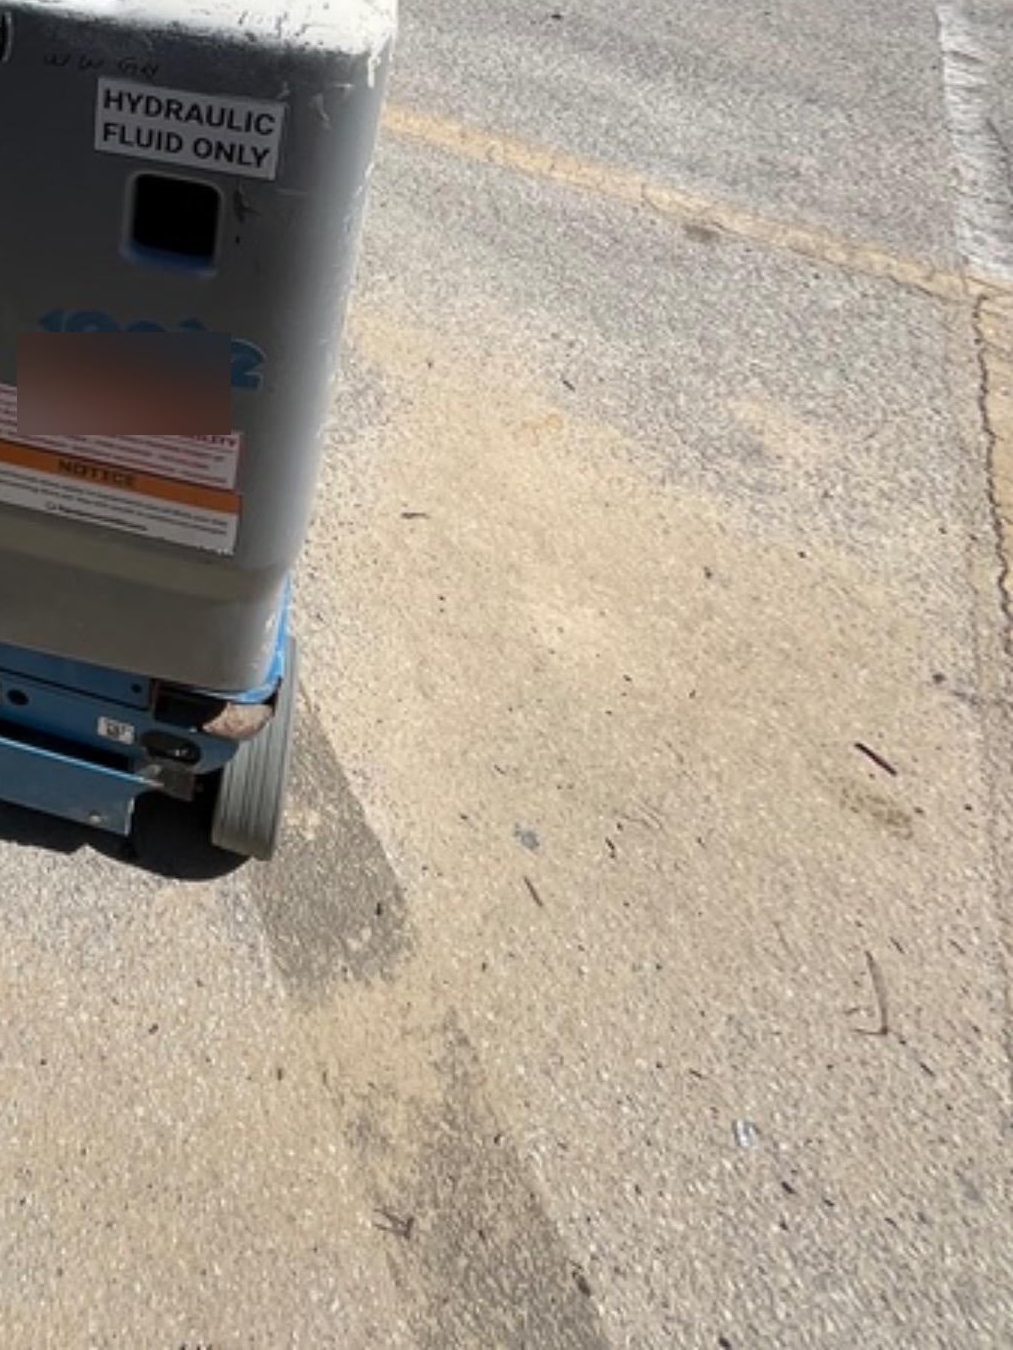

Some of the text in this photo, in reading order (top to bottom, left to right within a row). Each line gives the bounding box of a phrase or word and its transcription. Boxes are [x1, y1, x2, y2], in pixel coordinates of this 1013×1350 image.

[103, 88, 276, 136] HYDRAULIC
[102, 122, 270, 168] FLUID ONLY
[59, 459, 134, 486] NOTICE
